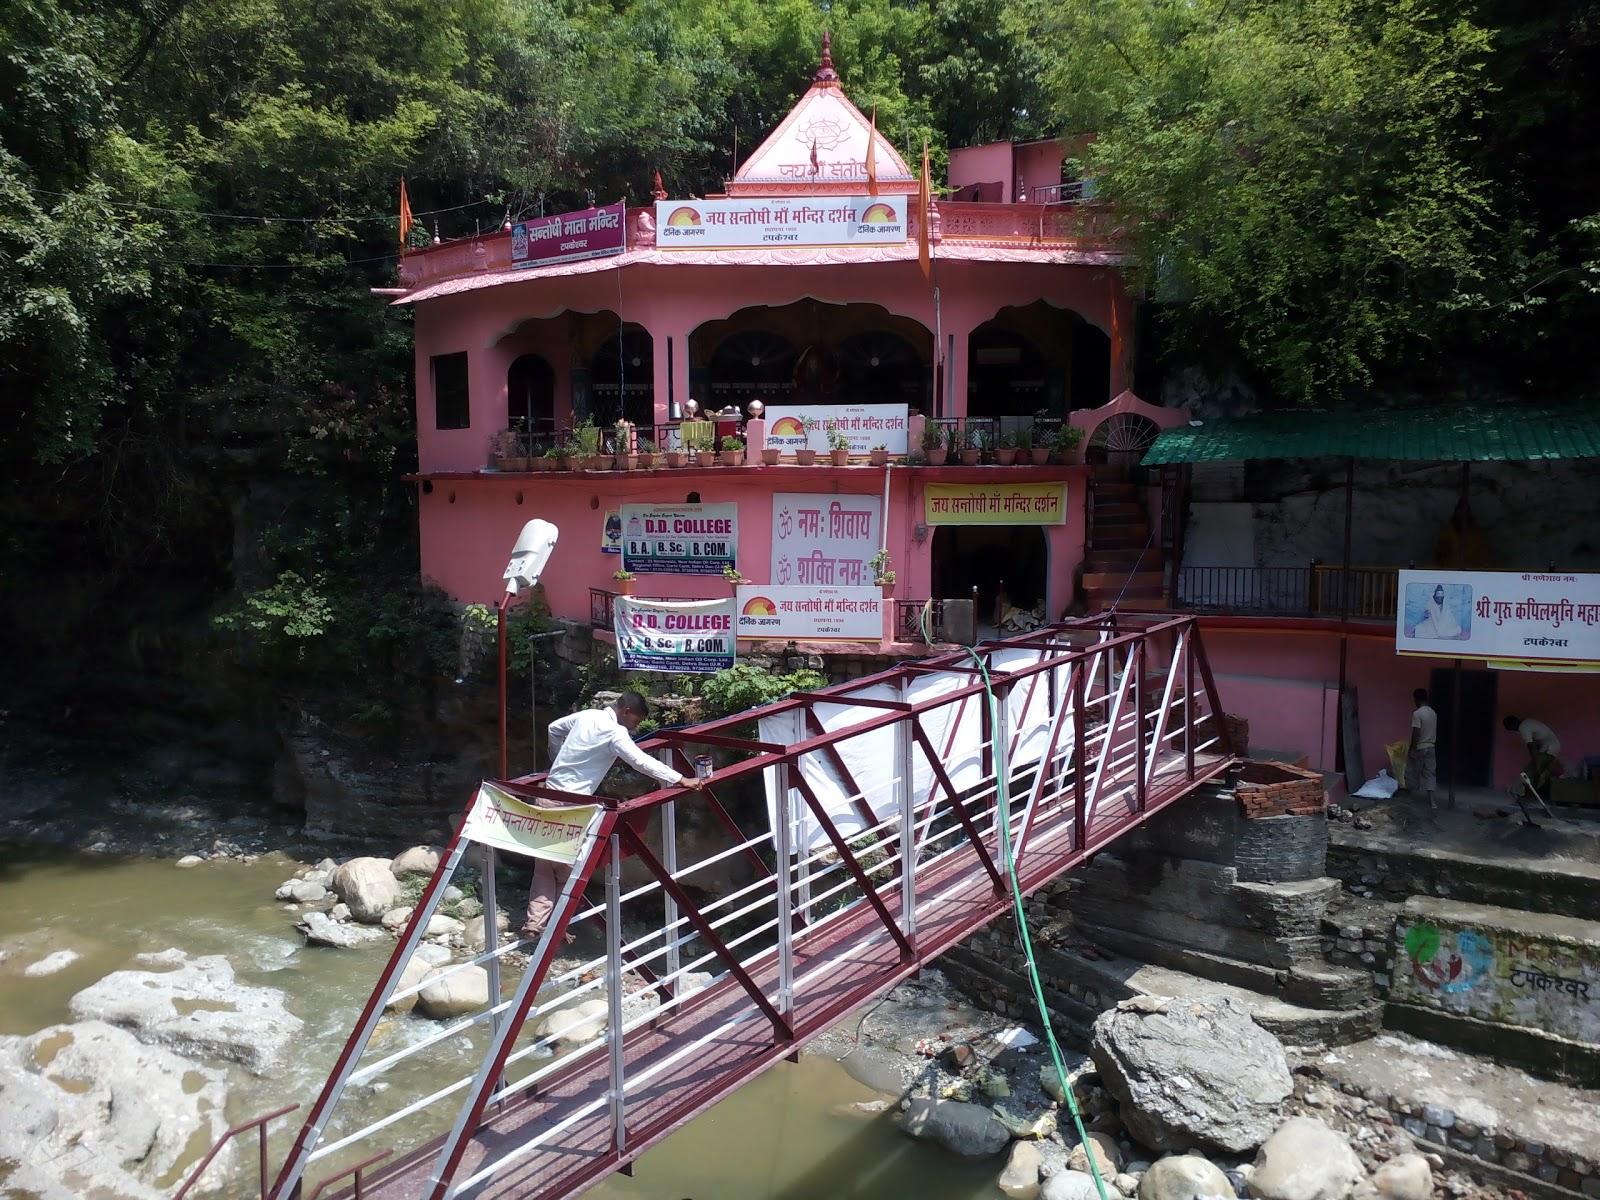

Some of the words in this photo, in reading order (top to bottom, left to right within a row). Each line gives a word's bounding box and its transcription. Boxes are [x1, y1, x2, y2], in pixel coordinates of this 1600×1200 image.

[777, 164, 808, 178] जय
[829, 158, 879, 179] संतोष
[706, 211, 726, 225] जय
[729, 207, 772, 225] सन्तोषी
[774, 207, 789, 224] माँ
[792, 206, 826, 224] मन्दिर
[828, 205, 858, 224] दर्शन
[529, 217, 563, 242] सन्तोषी
[564, 218, 587, 236] माता
[588, 209, 620, 231] मन्दिर
[663, 227, 682, 237] दैनिक
[682, 228, 706, 236] जागरण
[857, 225, 876, 234] दैनिक
[877, 225, 901, 233] जागरण
[850, 416, 861, 430] माँ
[862, 415, 884, 430] मन्दिर
[885, 415, 904, 430] दर्शन
[931, 497, 950, 513] जय
[952, 492, 988, 514] सन्तोषी
[988, 491, 1001, 513] माँ
[1003, 492, 1032, 513] मन्दिर
[1034, 492, 1059, 513] दर्शन
[645, 520, 671, 534] D.D.
[673, 519, 732, 534] COLLEGE
[829, 501, 873, 540] शिवाय
[797, 549, 837, 585] शक्ति
[780, 600, 794, 612] जय
[795, 598, 823, 613] सन्तोषी
[824, 598, 835, 613] माँ
[836, 597, 858, 613] मन्दिर
[859, 598, 879, 613] दर्शन
[1475, 595, 1491, 619] श्री
[1515, 597, 1575, 628] कपिलमुनि
[1577, 603, 1600, 626] महा
[664, 614, 731, 630] COLLEGE
[738, 617, 757, 626] दैनिक
[757, 618, 781, 626] जागरण
[1523, 637, 1569, 648] टपकेश्वर
